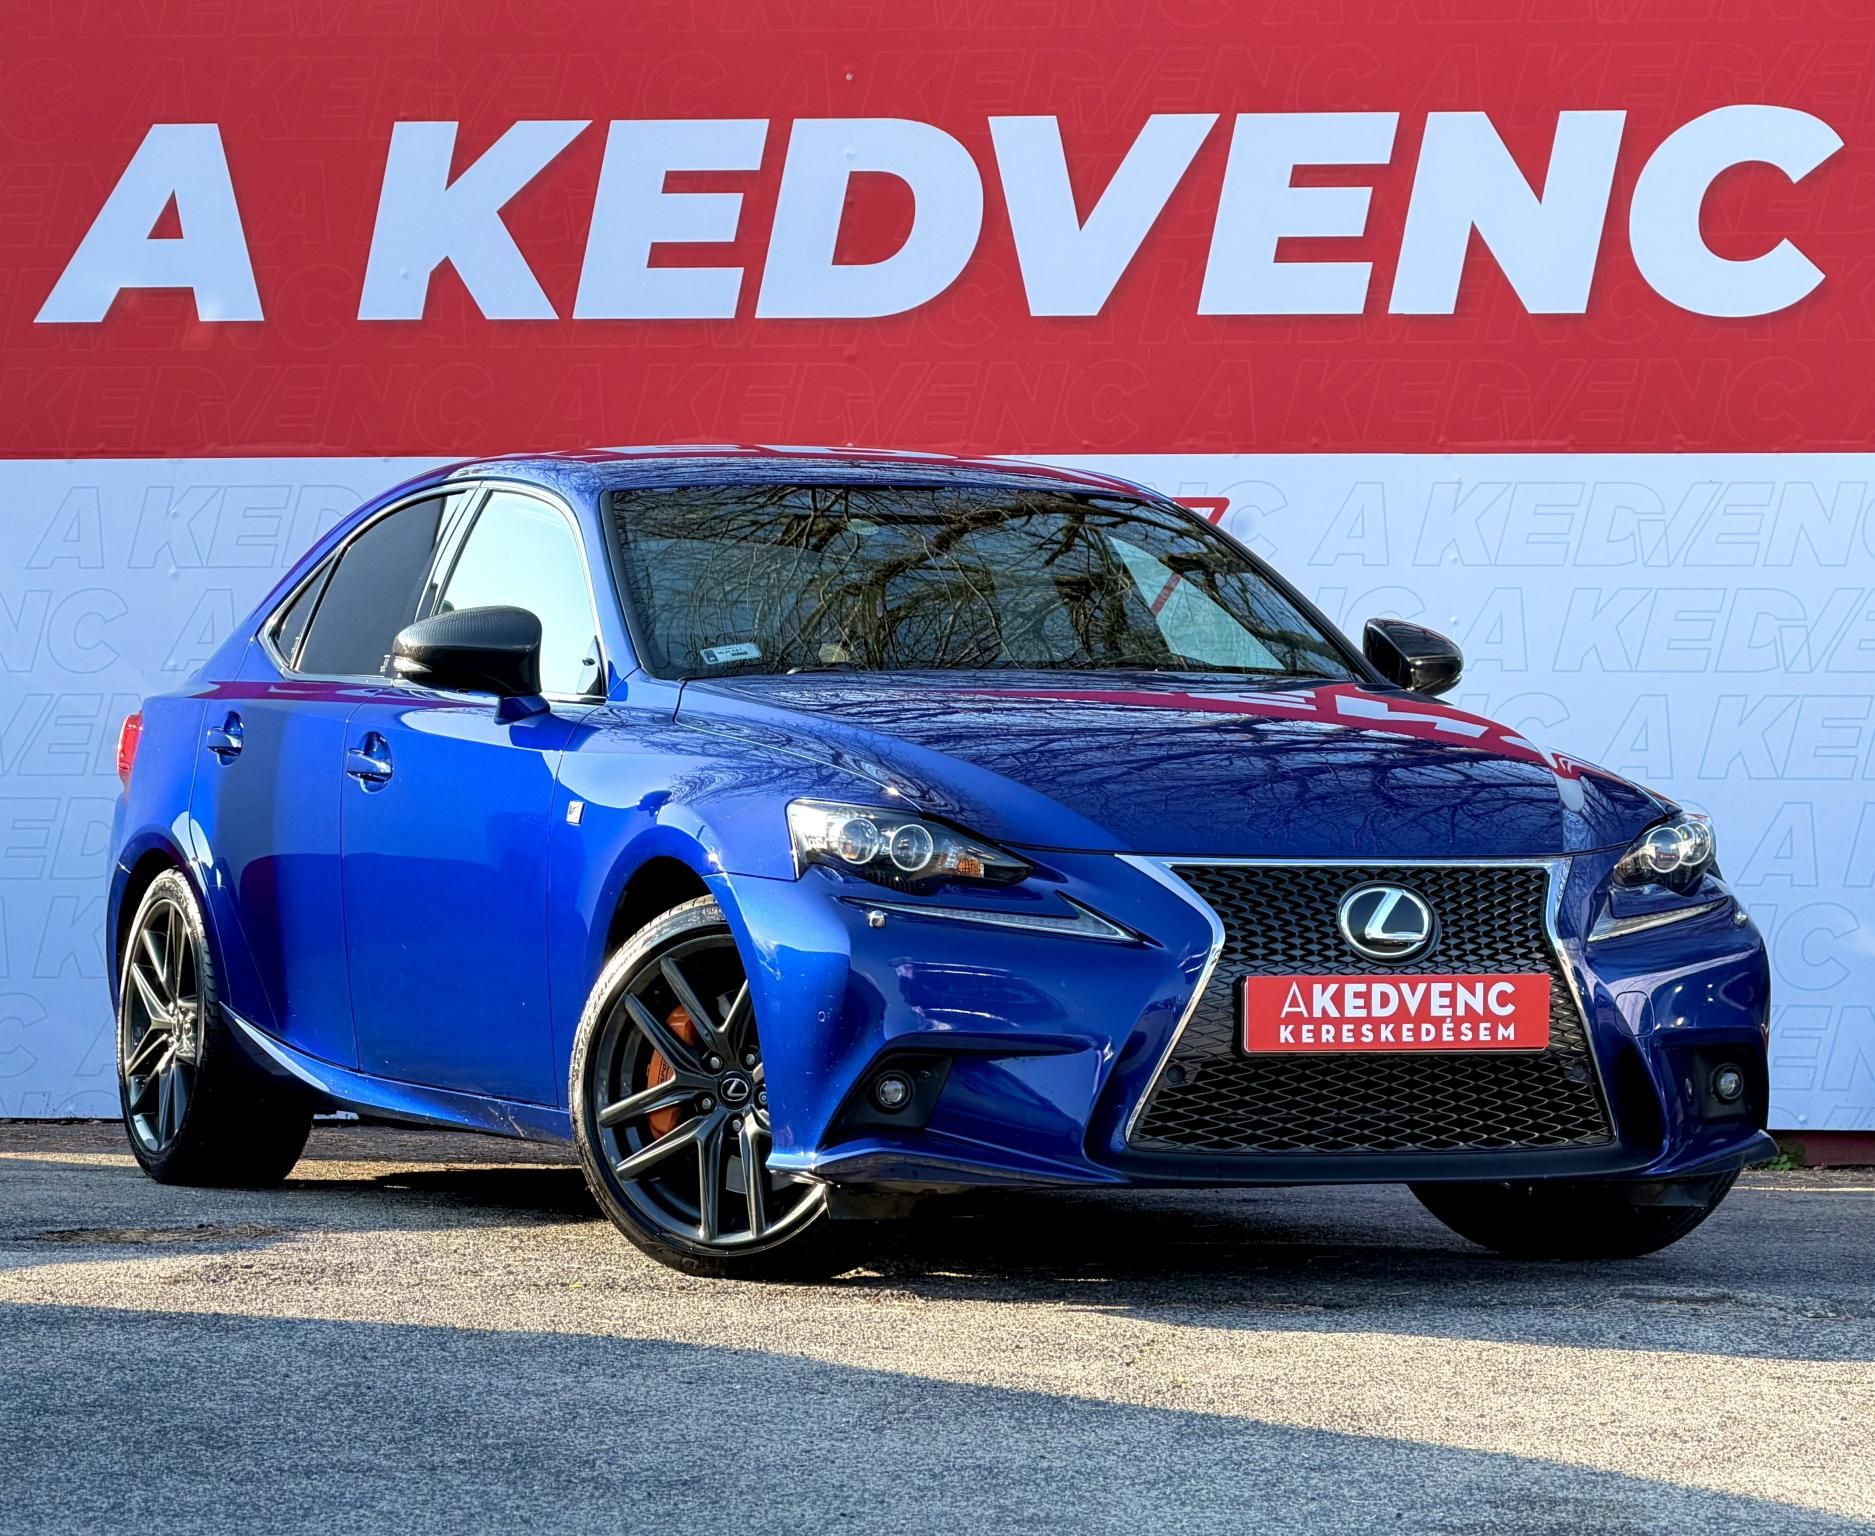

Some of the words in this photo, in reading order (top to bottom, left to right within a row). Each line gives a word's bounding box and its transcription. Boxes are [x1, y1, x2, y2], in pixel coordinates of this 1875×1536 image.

[32, 121, 265, 324] A
[357, 103, 1845, 321] KEDVENC
[25, 486, 105, 570] A
[1306, 481, 1391, 567] A
[1411, 481, 1875, 568] KEDVEN
[1734, 801, 1820, 887] A
[1279, 1018, 1516, 1044] KERESKEDÉSEM
